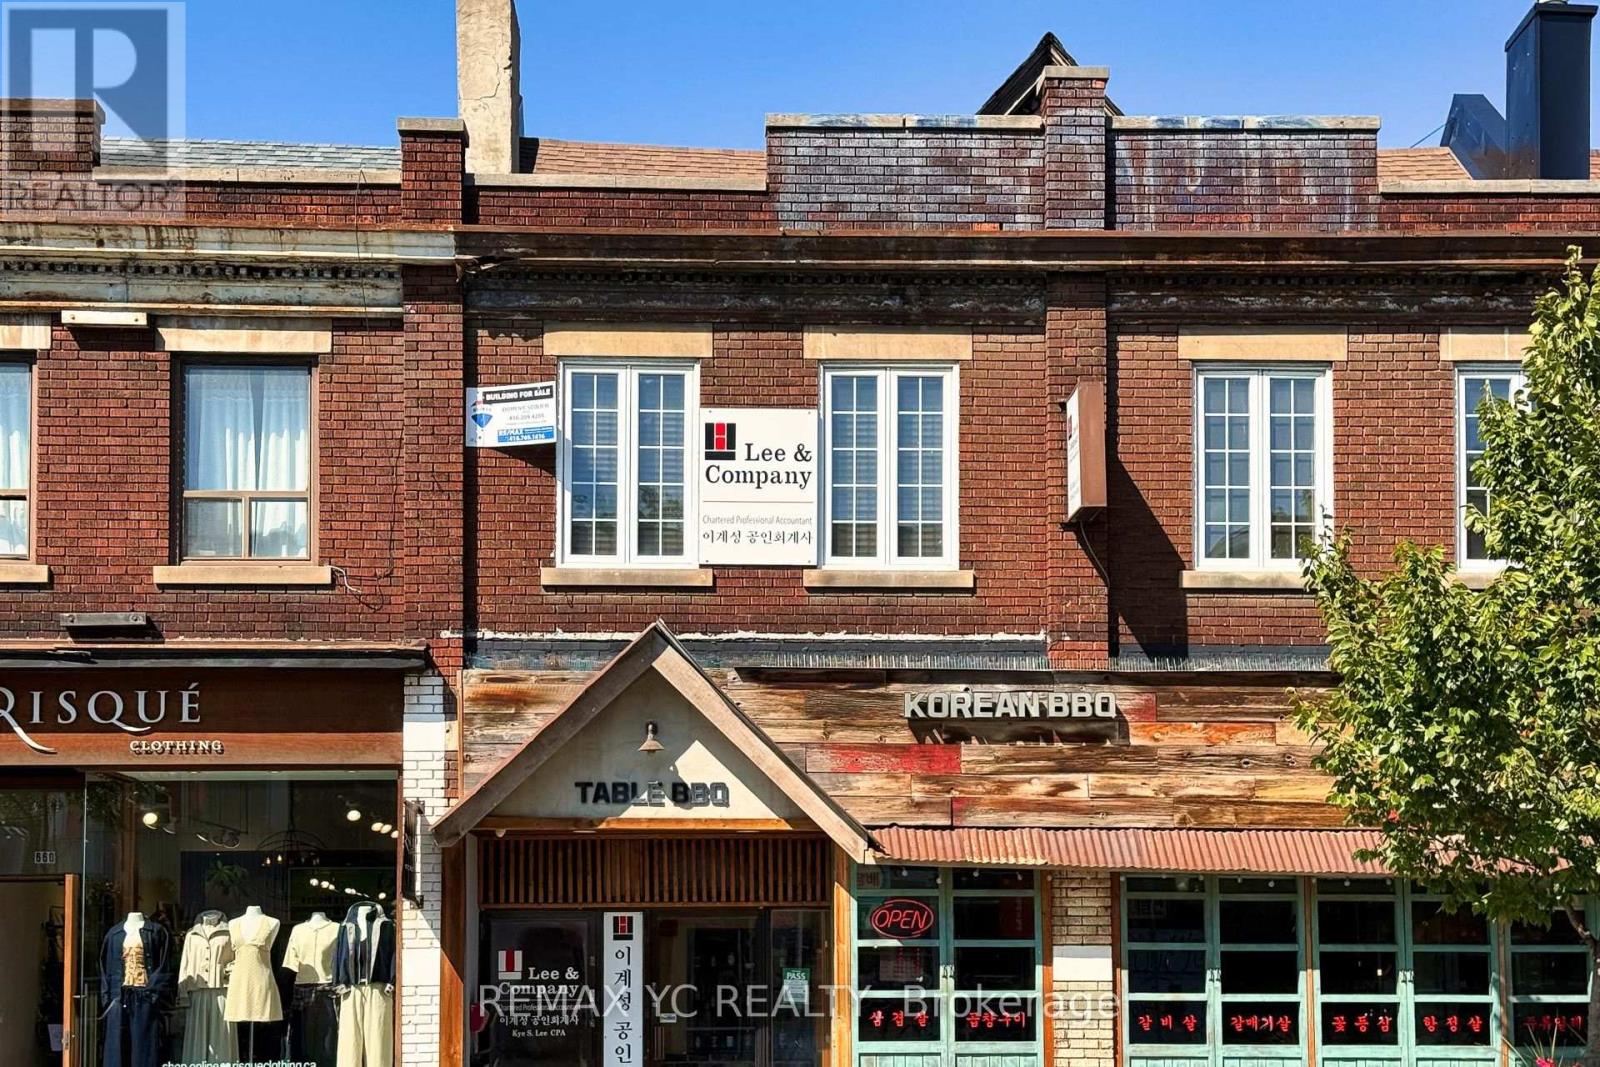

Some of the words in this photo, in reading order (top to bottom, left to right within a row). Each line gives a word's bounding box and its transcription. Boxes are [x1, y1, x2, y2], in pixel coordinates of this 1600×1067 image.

[485, 393, 518, 401] BUILDING
[519, 390, 533, 398] FOR
[534, 388, 551, 396] SALE
[744, 443, 786, 462] Lee
[794, 443, 812, 462] &
[705, 464, 812, 489] Company
[702, 514, 735, 525] Chartered
[736, 515, 774, 525] Professional
[775, 516, 812, 526] Accountant
[746, 529, 812, 545] 공인회계사
[904, 692, 1040, 718] KOREAN
[1047, 692, 1117, 718] BBQ
[0, 682, 201, 754] RISQUÉ
[129, 740, 222, 751] CLOTHING
[574, 781, 666, 807] TABLE
[671, 782, 730, 810] BBQ
[875, 910, 928, 929] OPEN
[528, 967, 560, 980] Lee
[564, 966, 579, 980] &
[615, 946, 632, 1012] 이계성
[786, 972, 806, 980] PASS
[500, 982, 579, 997] Company
[966, 1012, 1025, 1028] 곱창구이
[1230, 1015, 1291, 1032] 갈매기살
